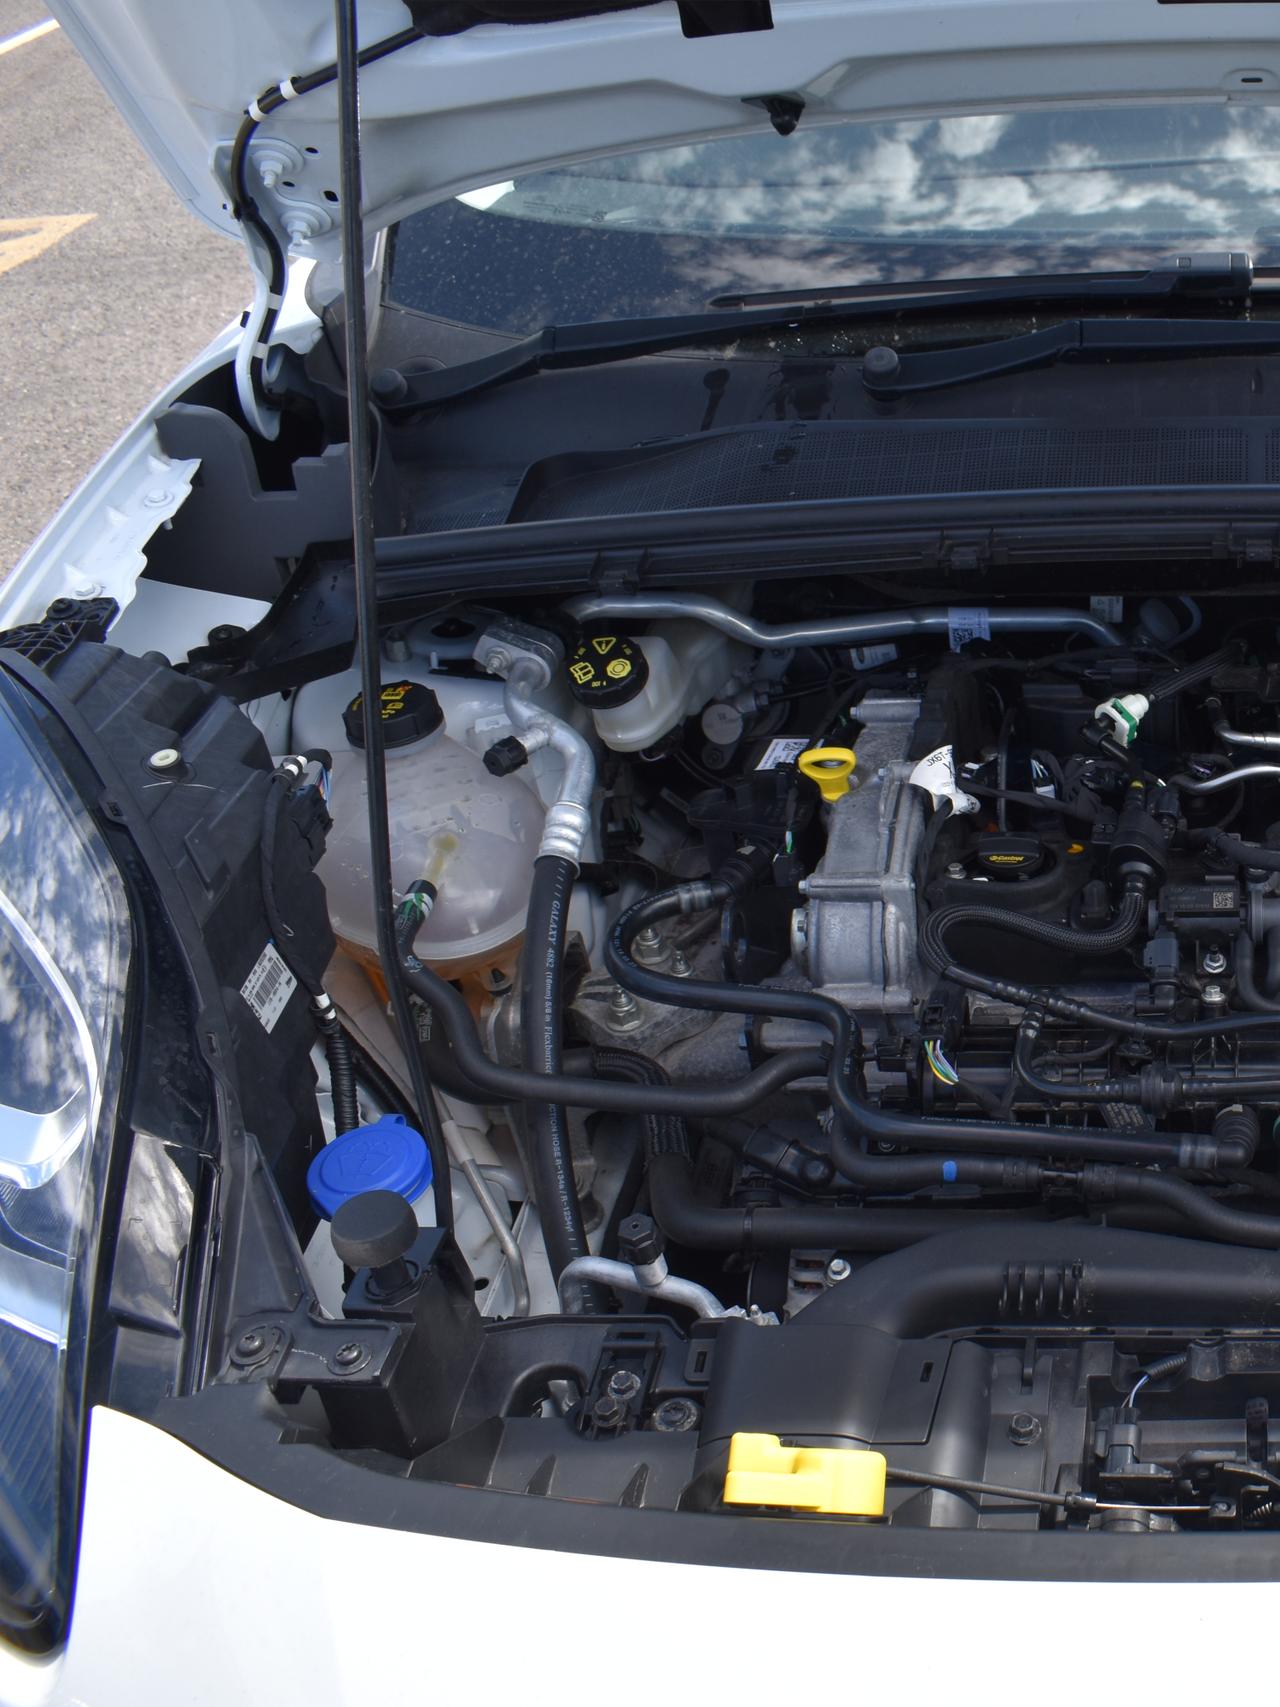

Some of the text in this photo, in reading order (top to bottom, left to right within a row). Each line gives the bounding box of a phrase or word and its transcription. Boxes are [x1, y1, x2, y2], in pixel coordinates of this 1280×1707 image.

[548, 900, 561, 945] GALAXY
[546, 947, 556, 968] 4882
[552, 1134, 562, 1157] HOSE
